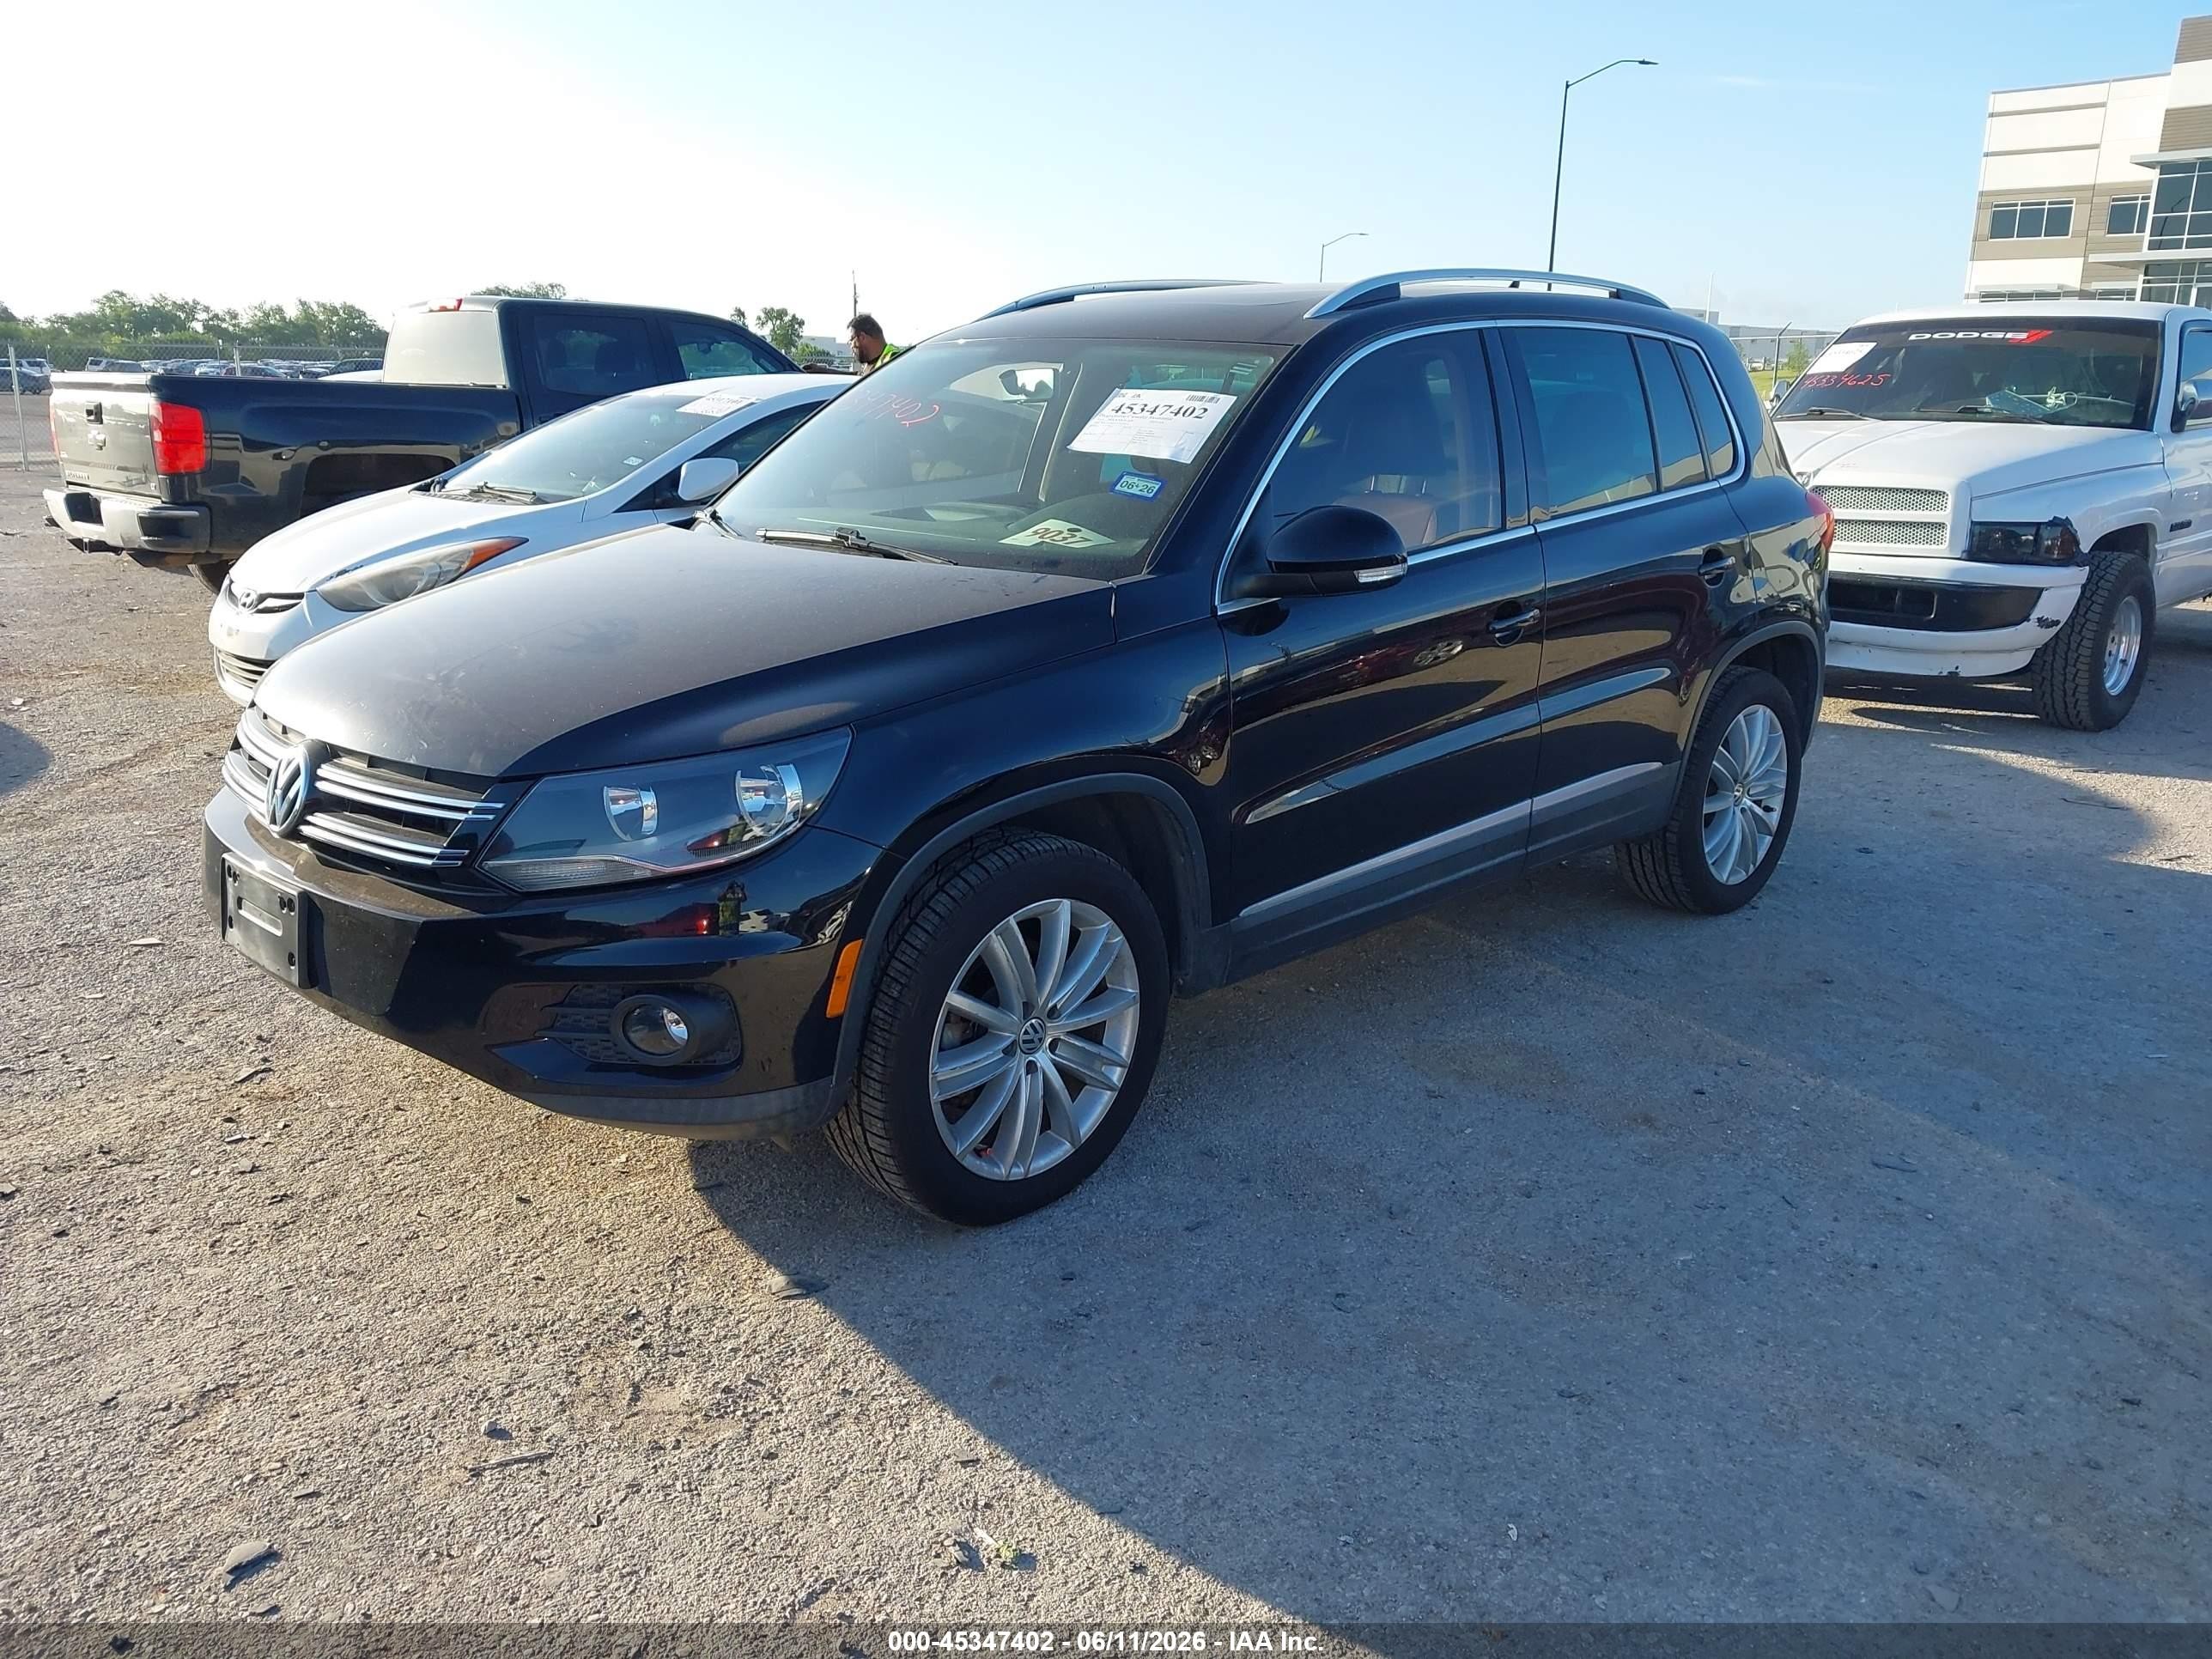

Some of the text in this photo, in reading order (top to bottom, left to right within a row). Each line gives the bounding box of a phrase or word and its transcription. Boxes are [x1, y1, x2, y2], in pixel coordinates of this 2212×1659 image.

[1908, 331, 2029, 341] DODGE
[1111, 402, 1210, 420] 45347402
[1120, 480, 1136, 490] 06
[1139, 483, 1156, 495] 26
[1024, 527, 1093, 545] 9037
